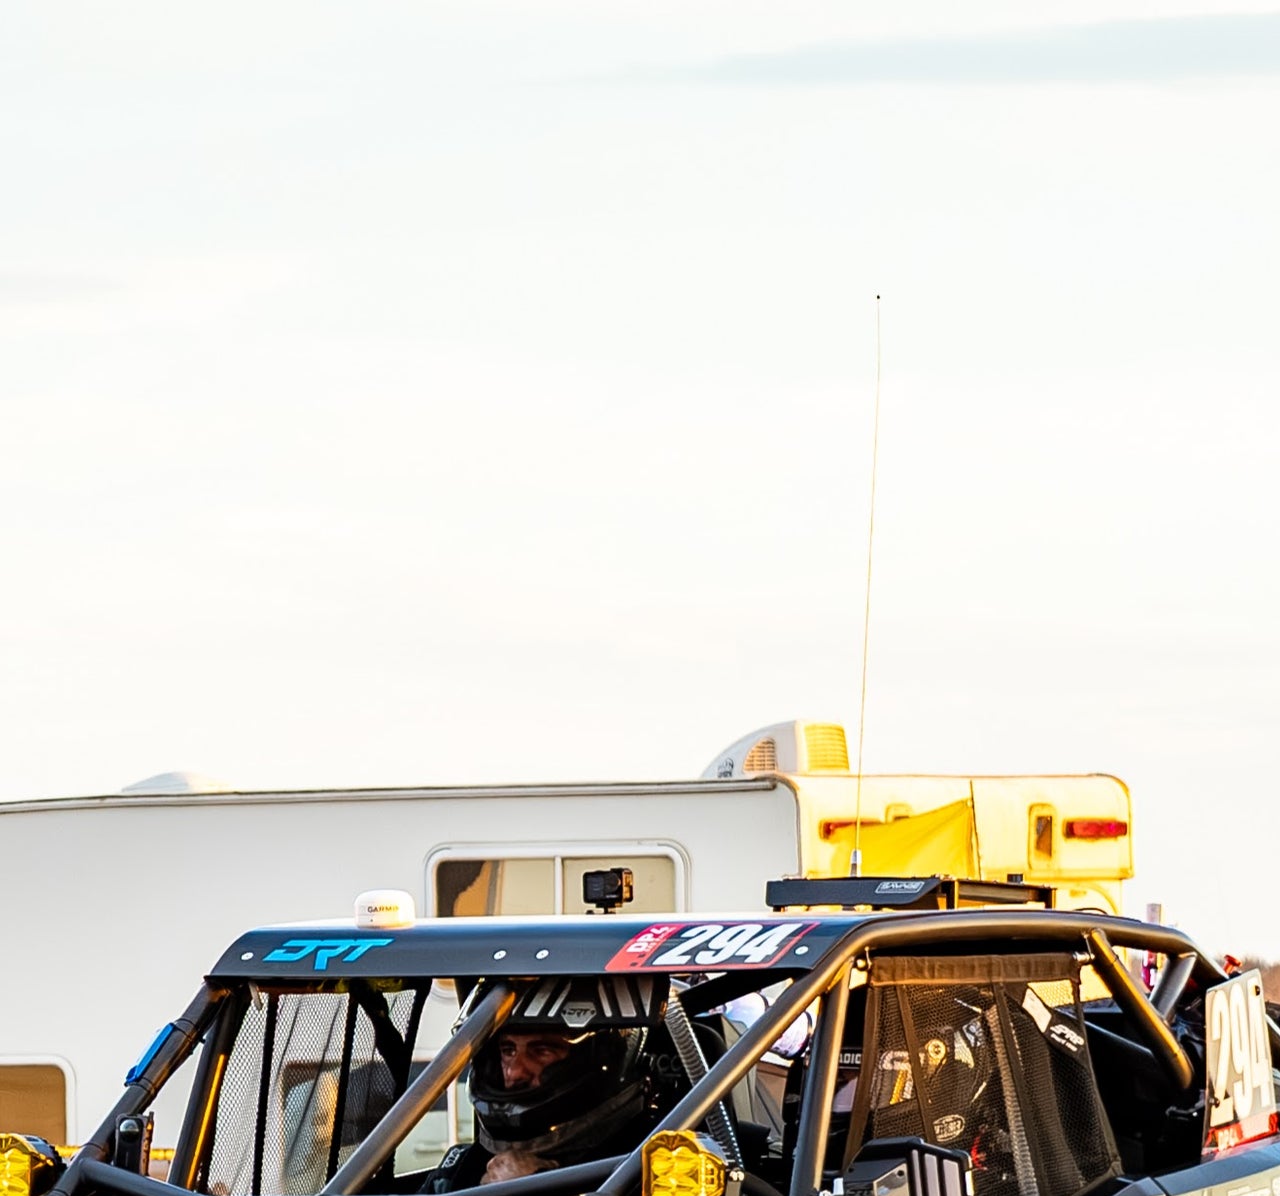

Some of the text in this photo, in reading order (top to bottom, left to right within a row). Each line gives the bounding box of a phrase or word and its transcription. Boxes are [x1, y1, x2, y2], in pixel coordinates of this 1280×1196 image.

[262, 938, 395, 971] DRT
[651, 922, 803, 965] 294
[1210, 976, 1271, 1127] 294
